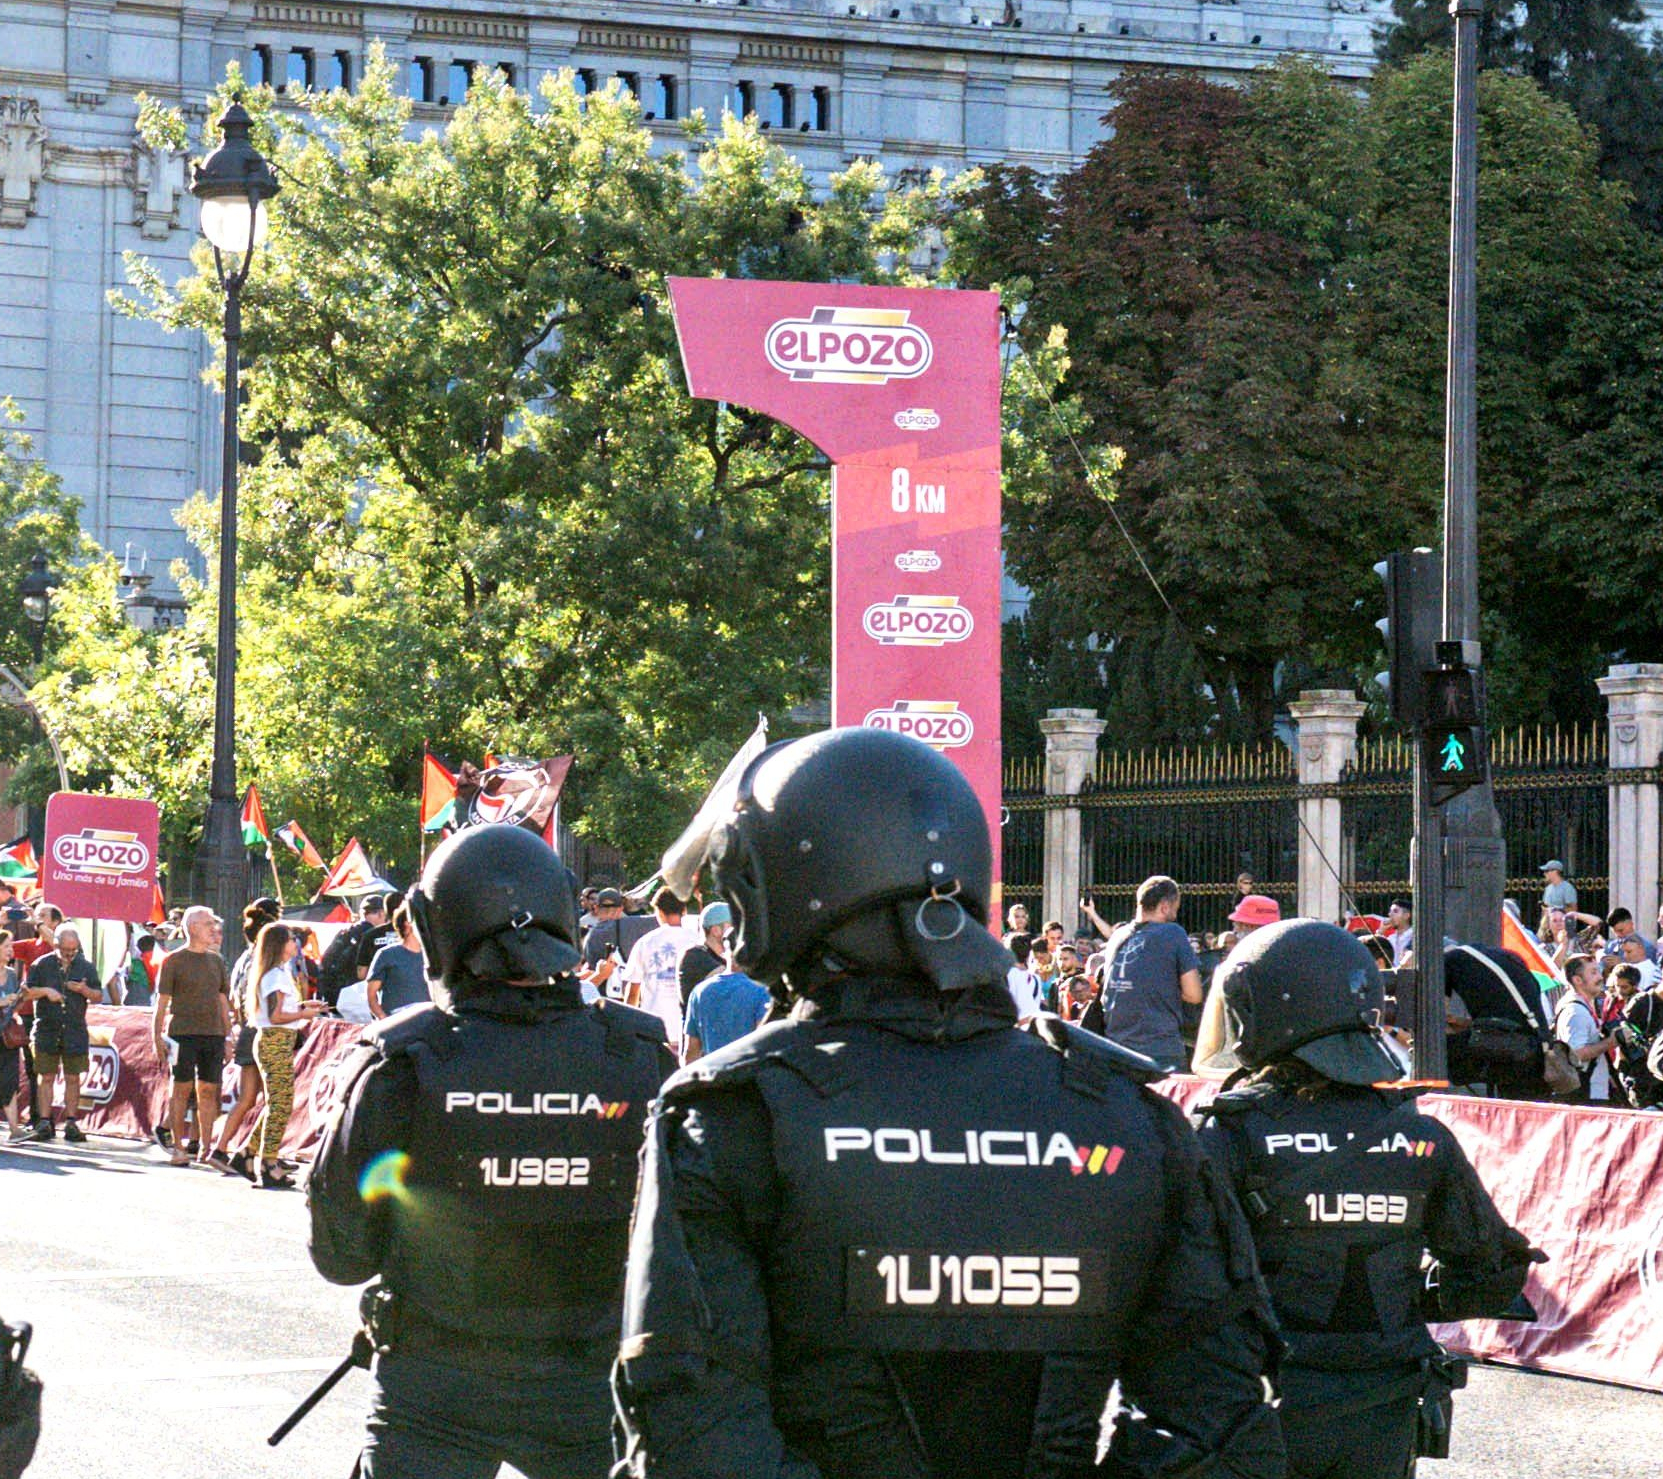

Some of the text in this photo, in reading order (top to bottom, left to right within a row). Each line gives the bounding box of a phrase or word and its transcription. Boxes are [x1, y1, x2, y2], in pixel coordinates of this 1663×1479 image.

[891, 467, 946, 514] 8 KM
[445, 1091, 605, 1115] POLICIA
[823, 1127, 1084, 1166] POLICIA
[479, 1156, 591, 1186] 1U982
[1304, 1192, 1409, 1224] 1U983
[876, 1254, 1082, 1306] 1U1055
